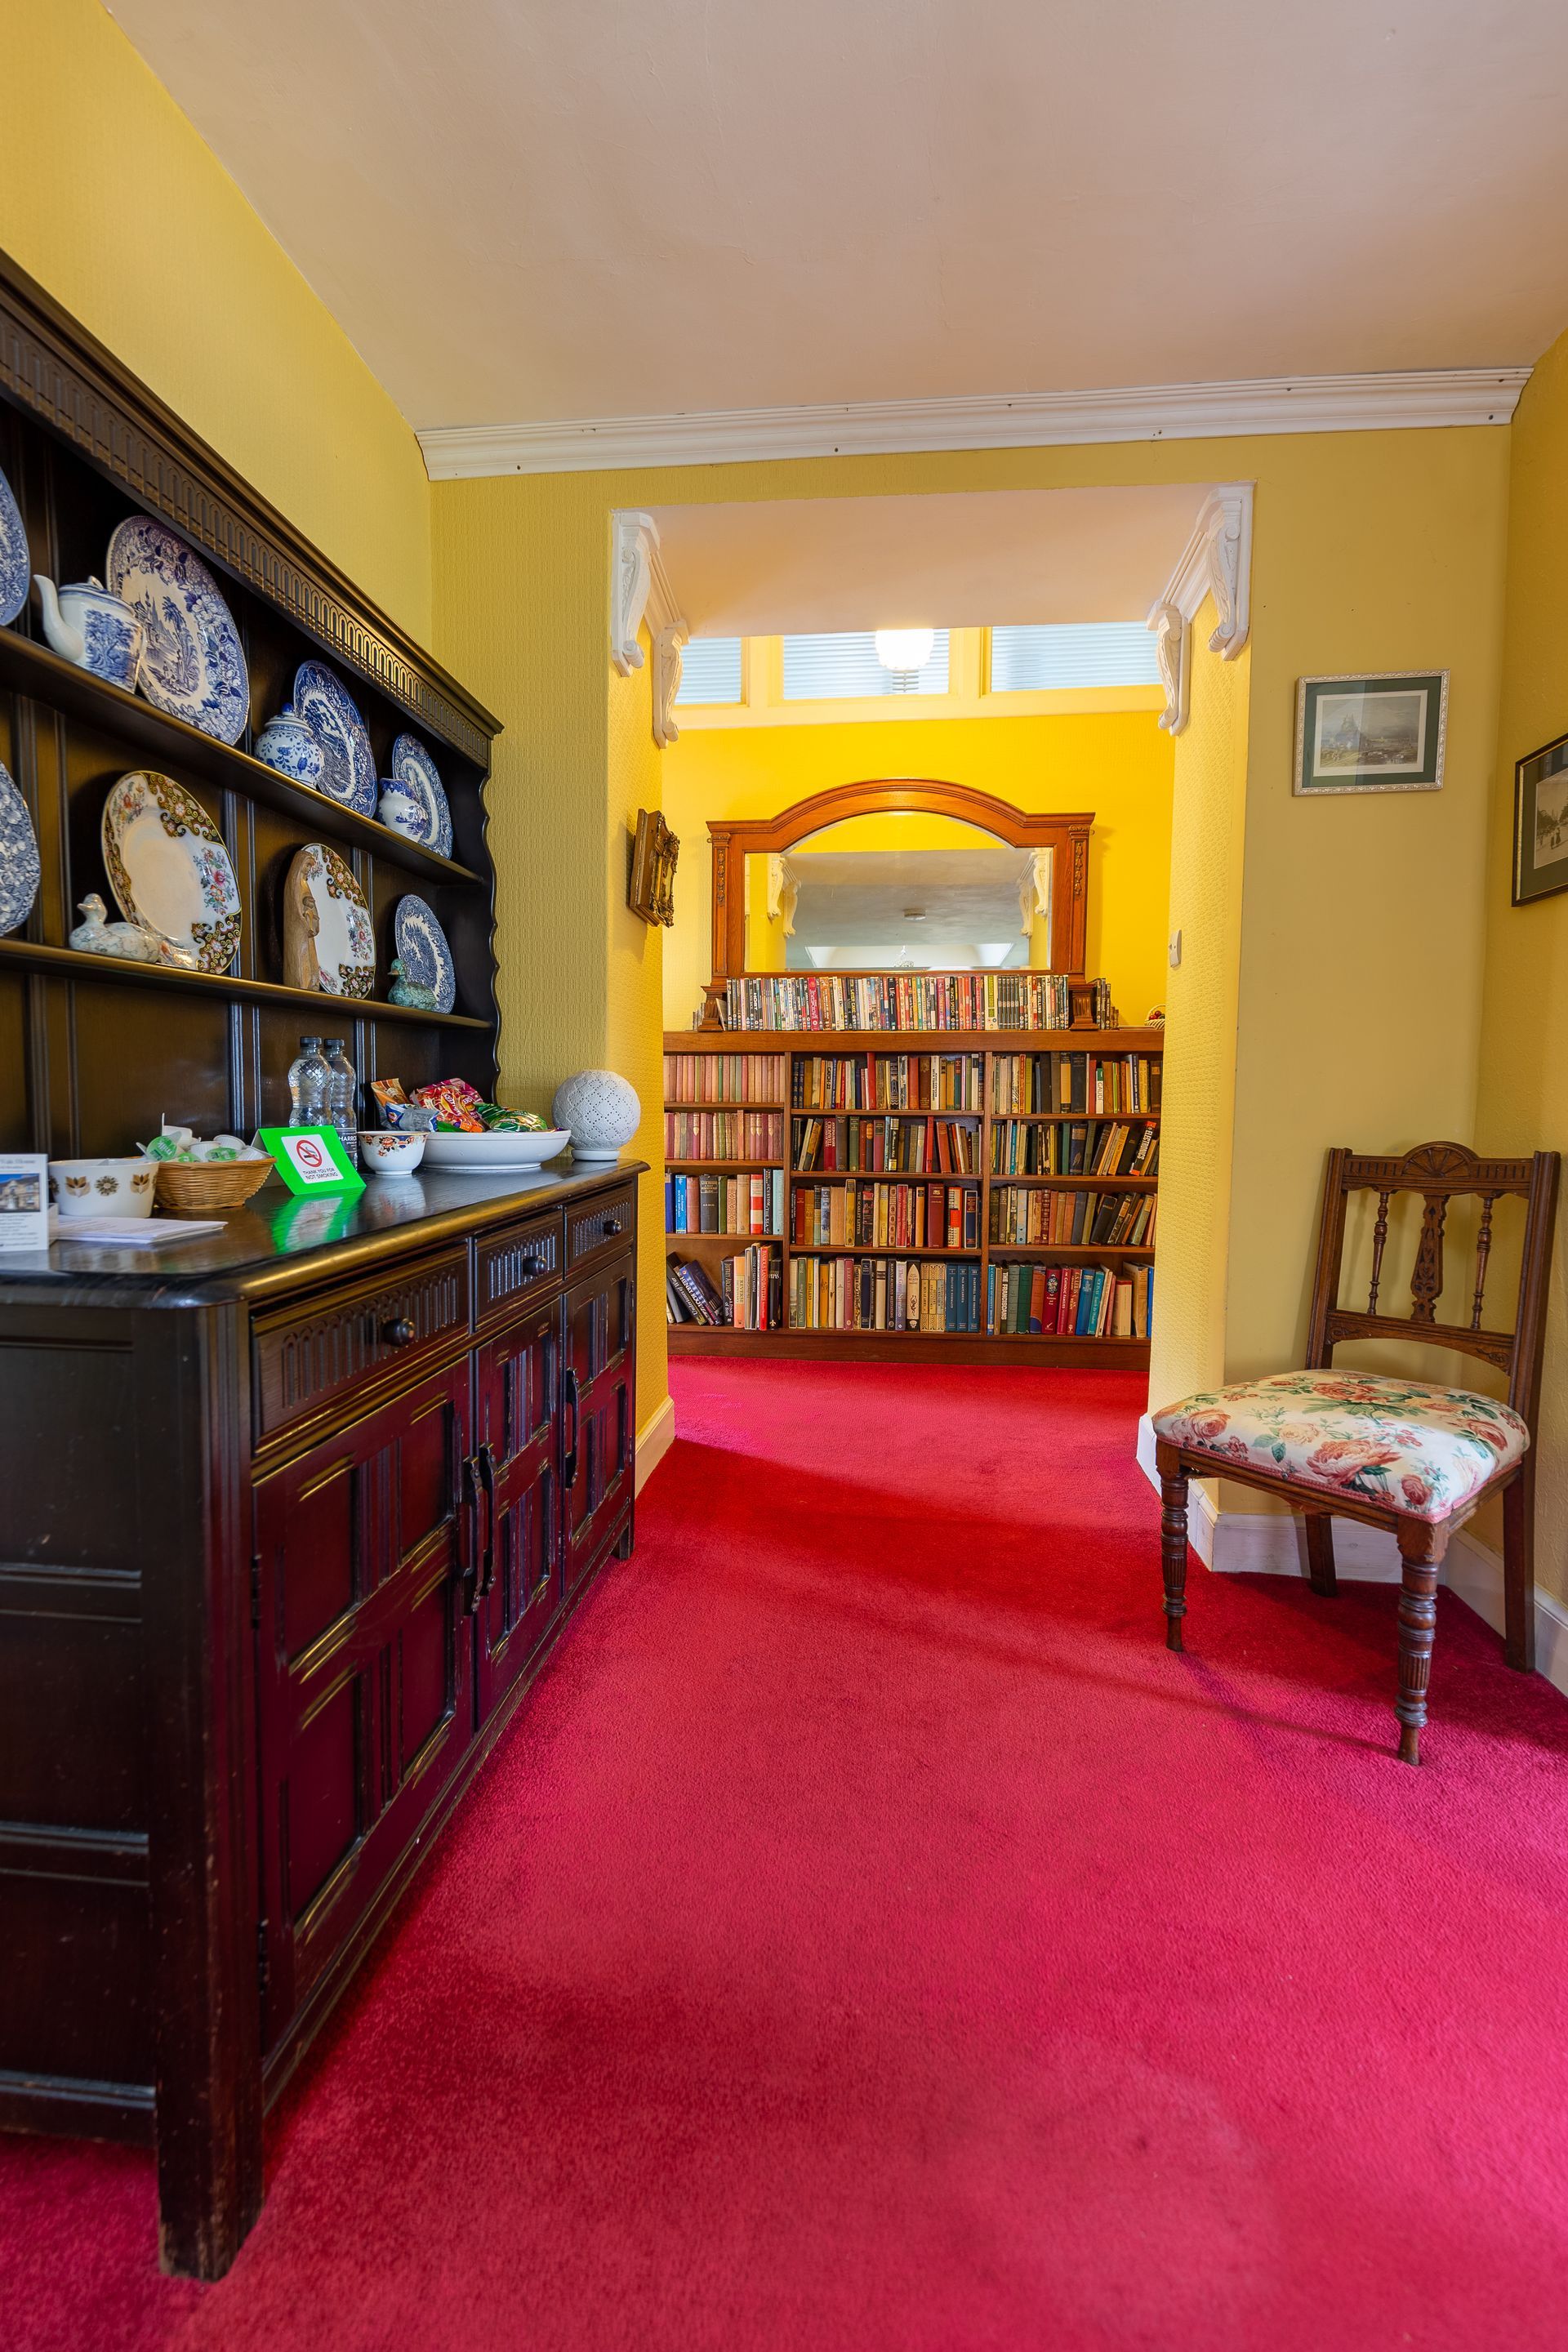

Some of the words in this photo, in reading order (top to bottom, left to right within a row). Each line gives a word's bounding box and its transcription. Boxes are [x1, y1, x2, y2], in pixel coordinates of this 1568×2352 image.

[1137, 1129, 1153, 1160] ELECTRONICS
[679, 1276, 693, 1294] HENRY
[690, 1294, 702, 1307] ROOT
[681, 1290, 697, 1316] Undertones
